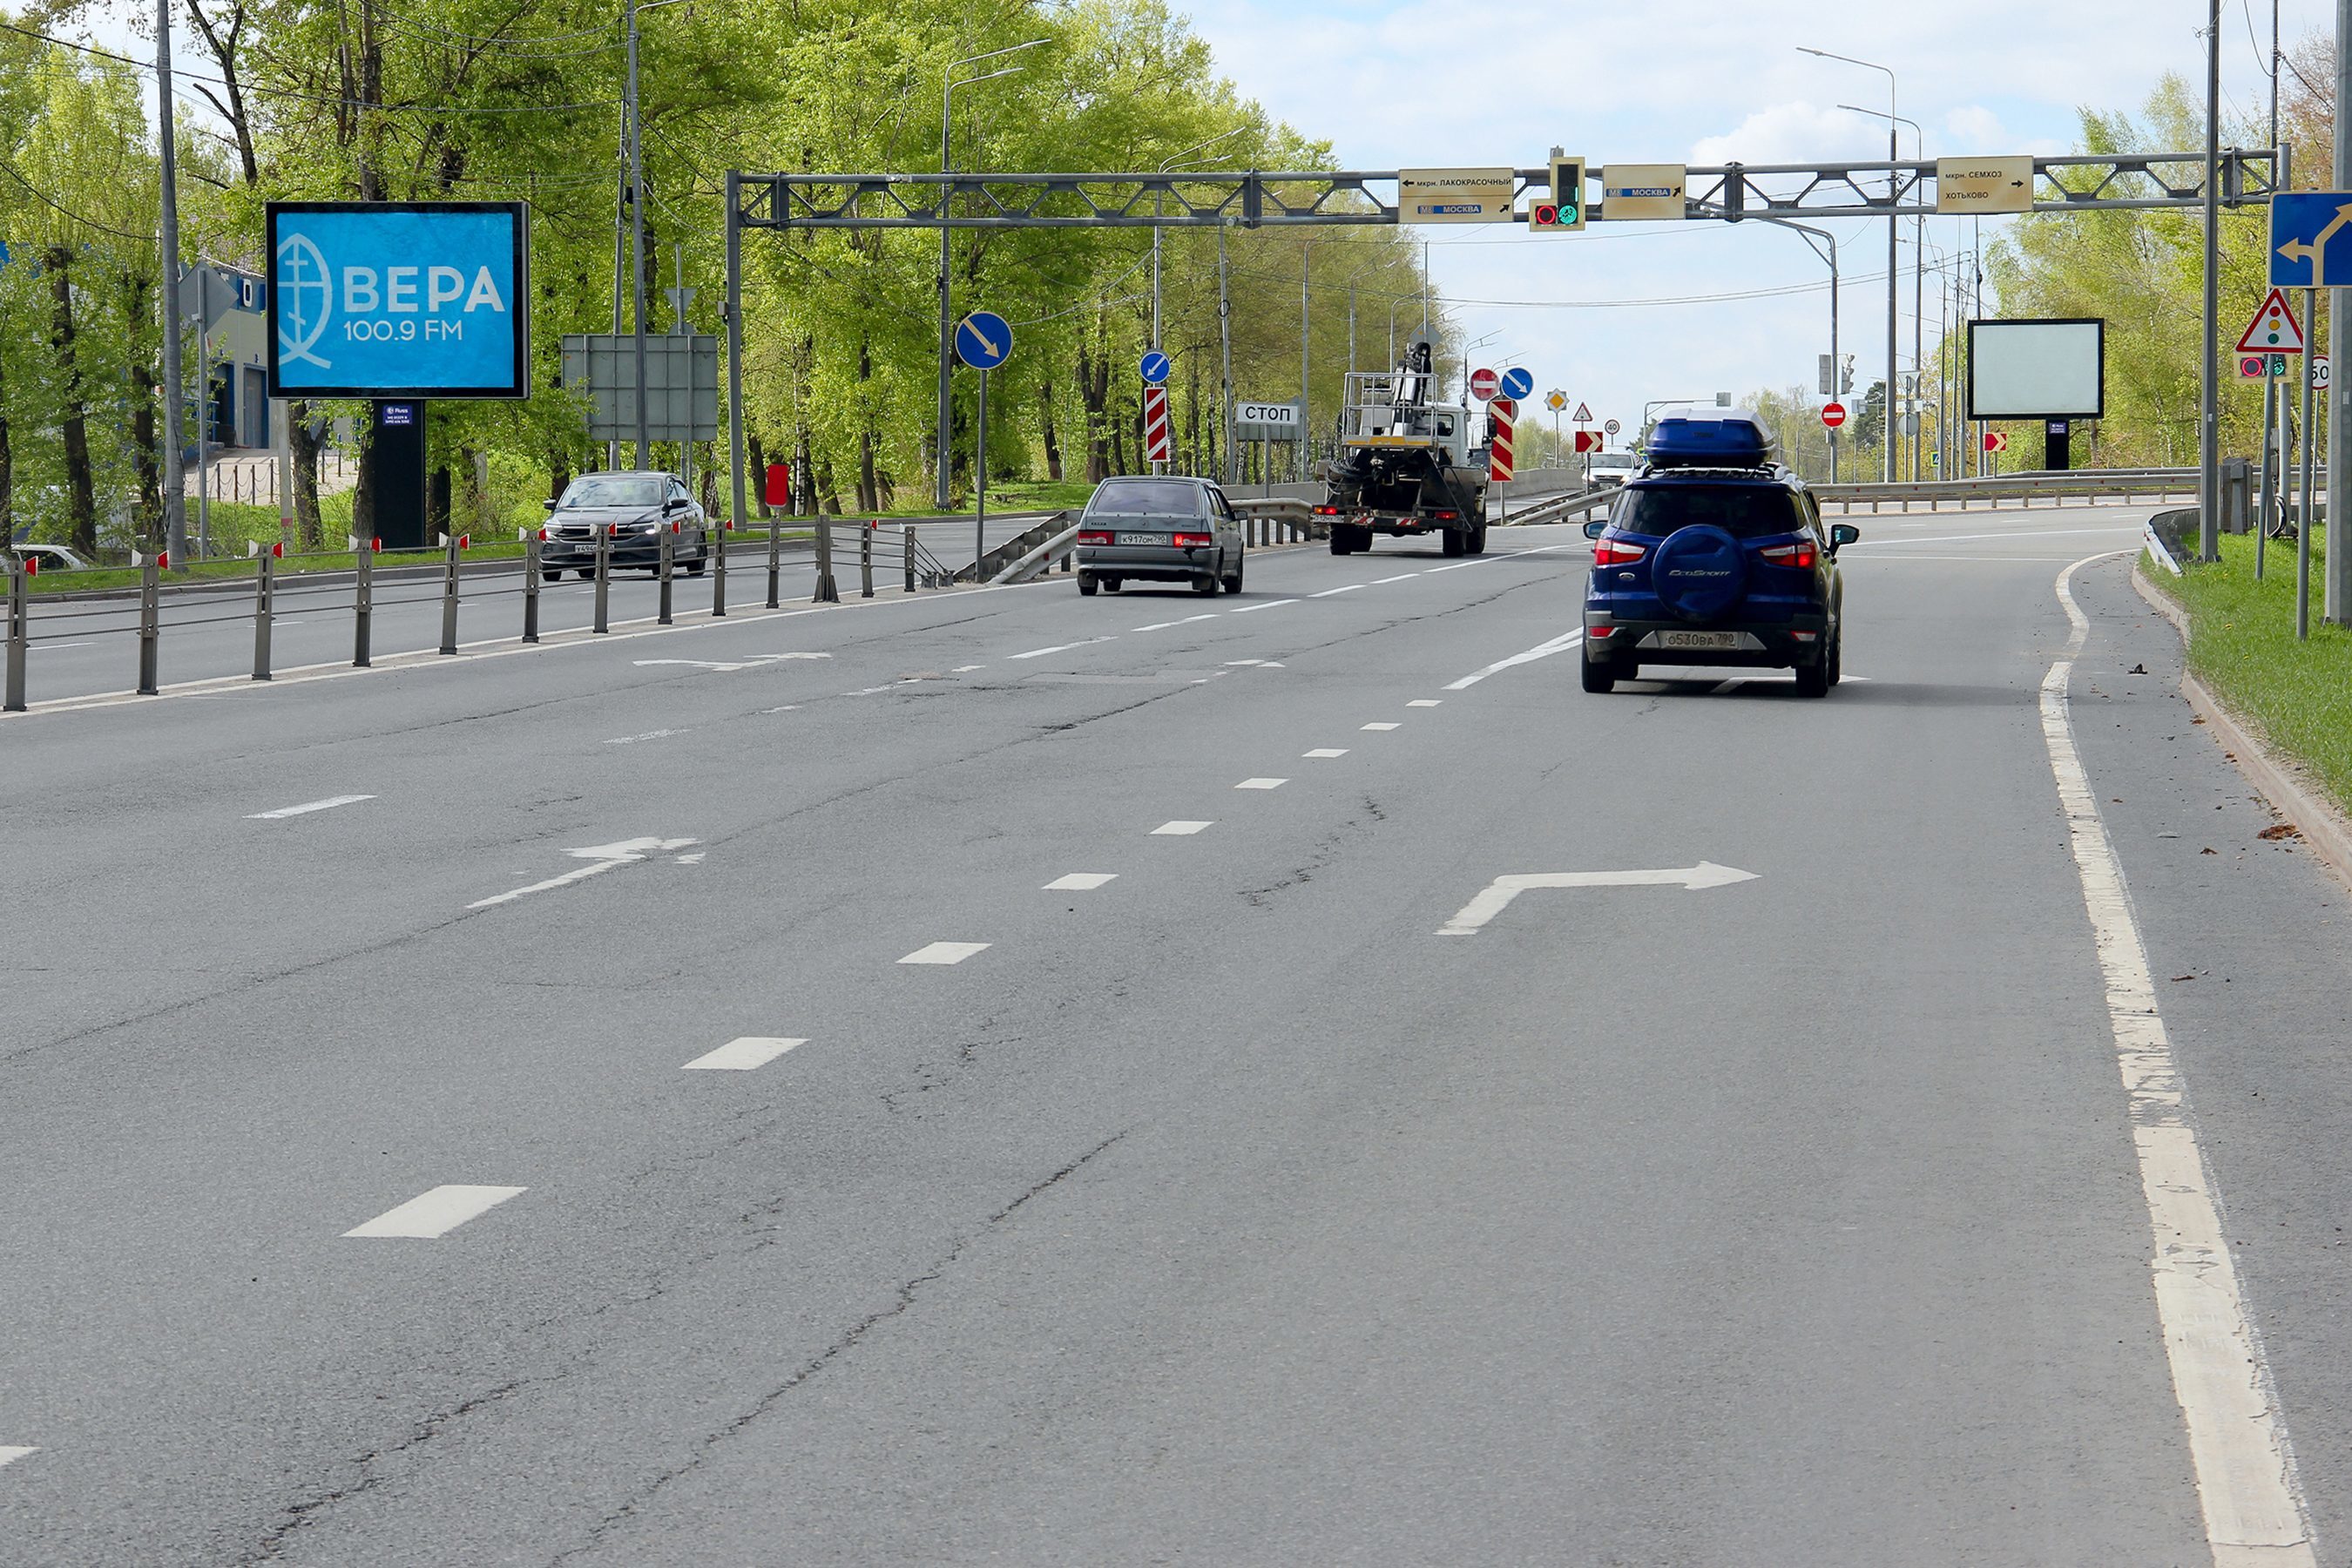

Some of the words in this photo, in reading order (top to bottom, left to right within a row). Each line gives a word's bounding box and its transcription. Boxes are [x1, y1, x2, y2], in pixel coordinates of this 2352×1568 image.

[1440, 177, 1511, 186] ЛАКОКРАСОЧНЫЙ
[343, 266, 505, 313] ВЕРА
[343, 320, 416, 341] 100.9
[424, 320, 463, 341] FM
[1245, 406, 1291, 422] СТОП
